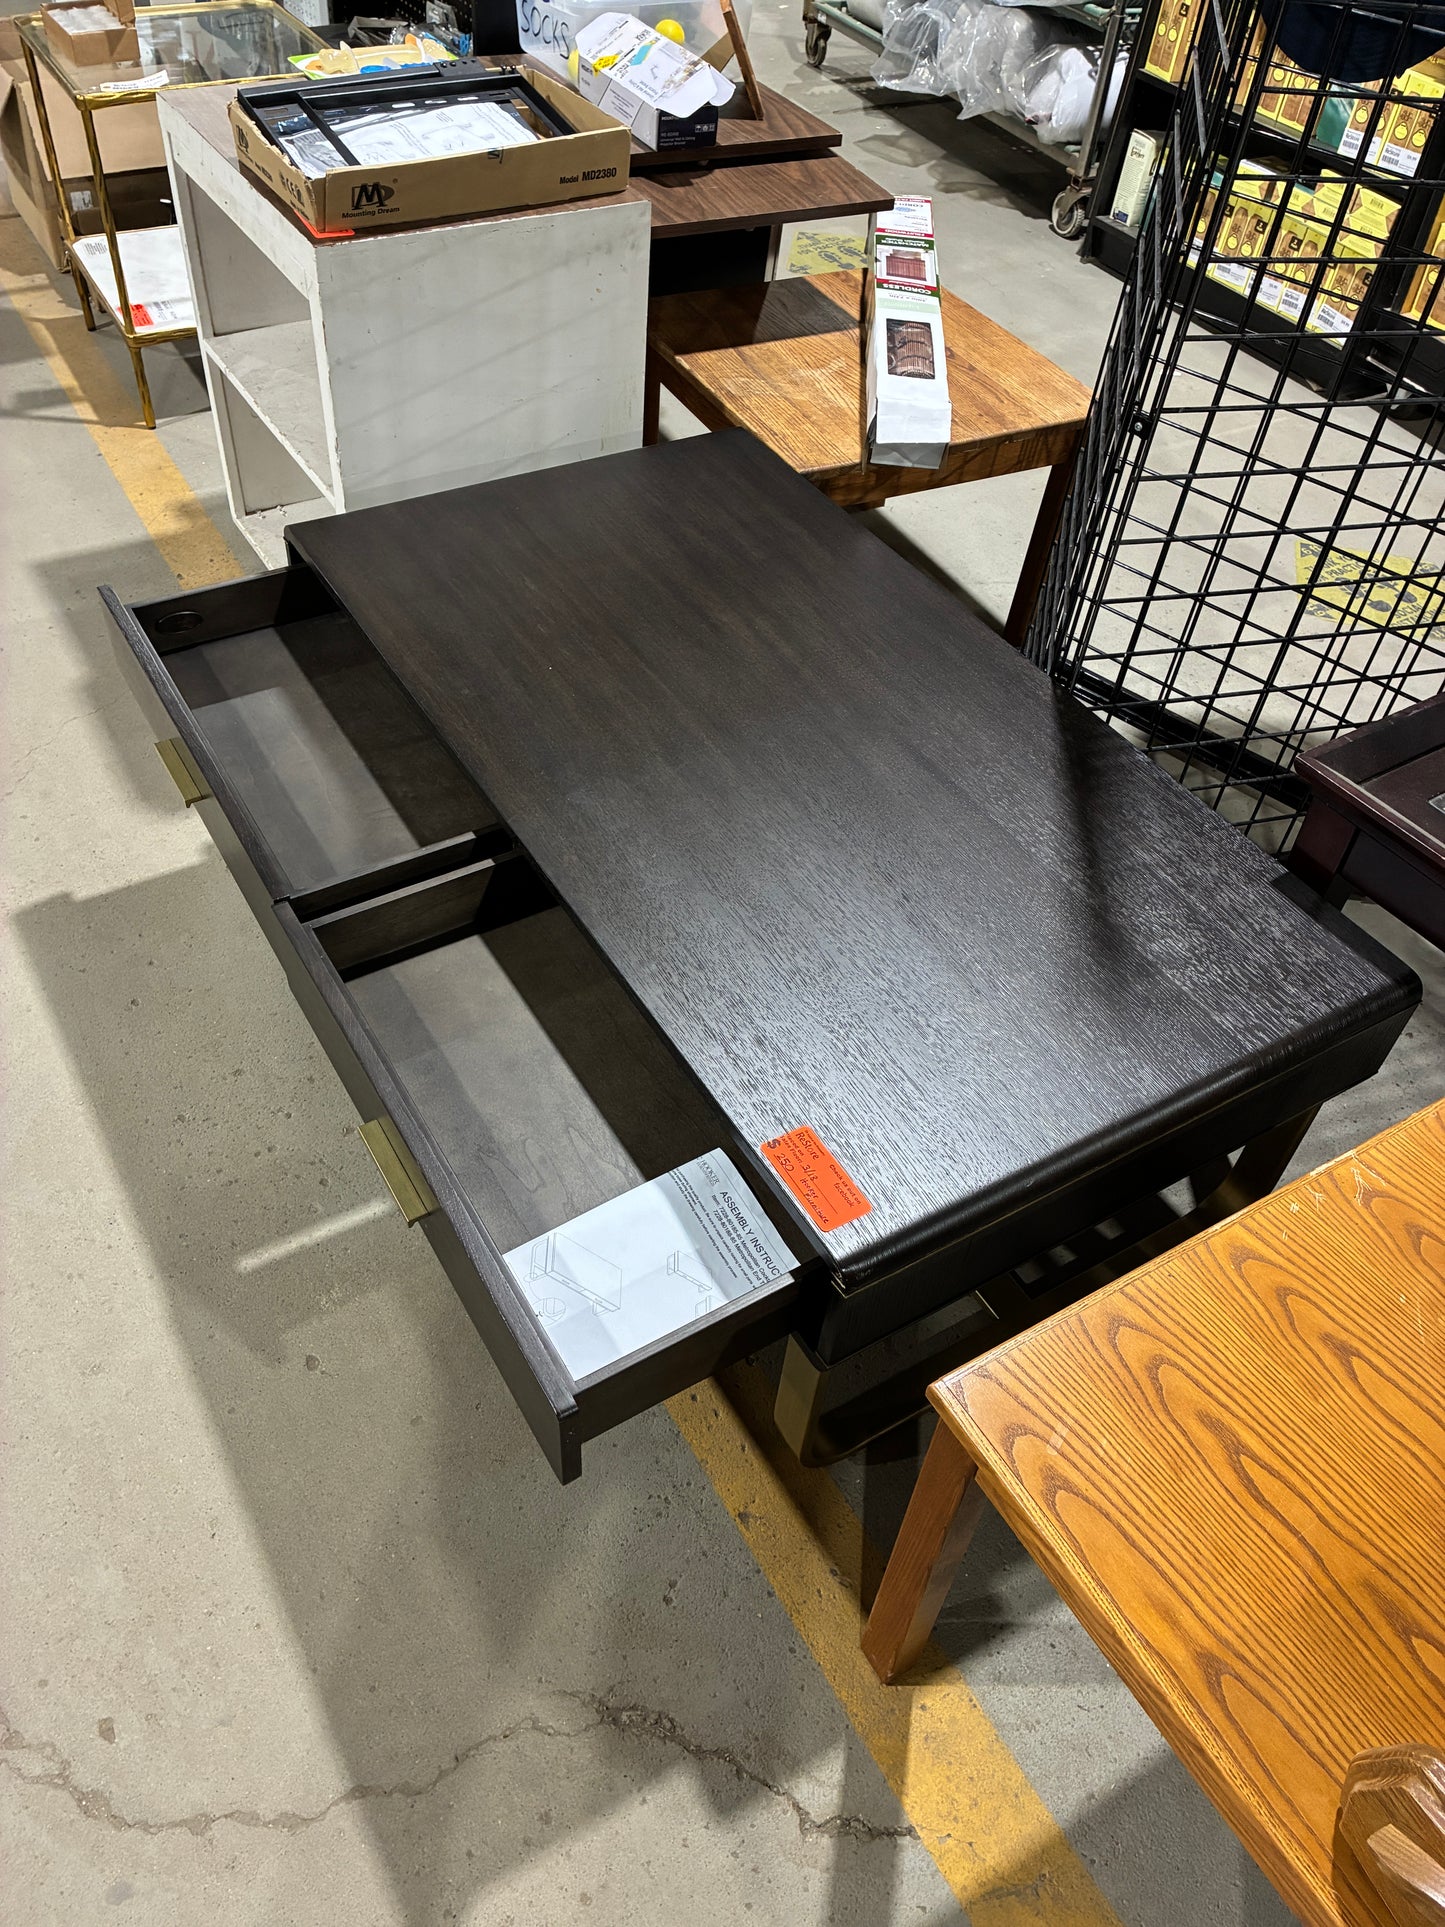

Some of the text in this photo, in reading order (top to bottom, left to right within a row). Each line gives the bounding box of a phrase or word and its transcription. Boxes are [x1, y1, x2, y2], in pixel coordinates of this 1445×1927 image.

[521, 0, 569, 60] SOCKS
[559, 167, 617, 184] Model MD2380
[342, 207, 400, 219] Mounting Dream
[883, 283, 931, 294] CORDLESS
[766, 1138, 795, 1172] $ 250
[795, 1132, 819, 1160] ReStore
[699, 1159, 720, 1184] HOOKER
[802, 1164, 818, 1182] 3/18
[829, 1164, 843, 1180] Check
[847, 1187, 856, 1197] out
[855, 1197, 861, 1205] on
[833, 1182, 854, 1208] facebook
[718, 1190, 754, 1237] ASSEMBLY
[733, 1243, 754, 1271] Metropolitan
[752, 1270, 761, 1280] End
[739, 1239, 760, 1268] Metropolitan
